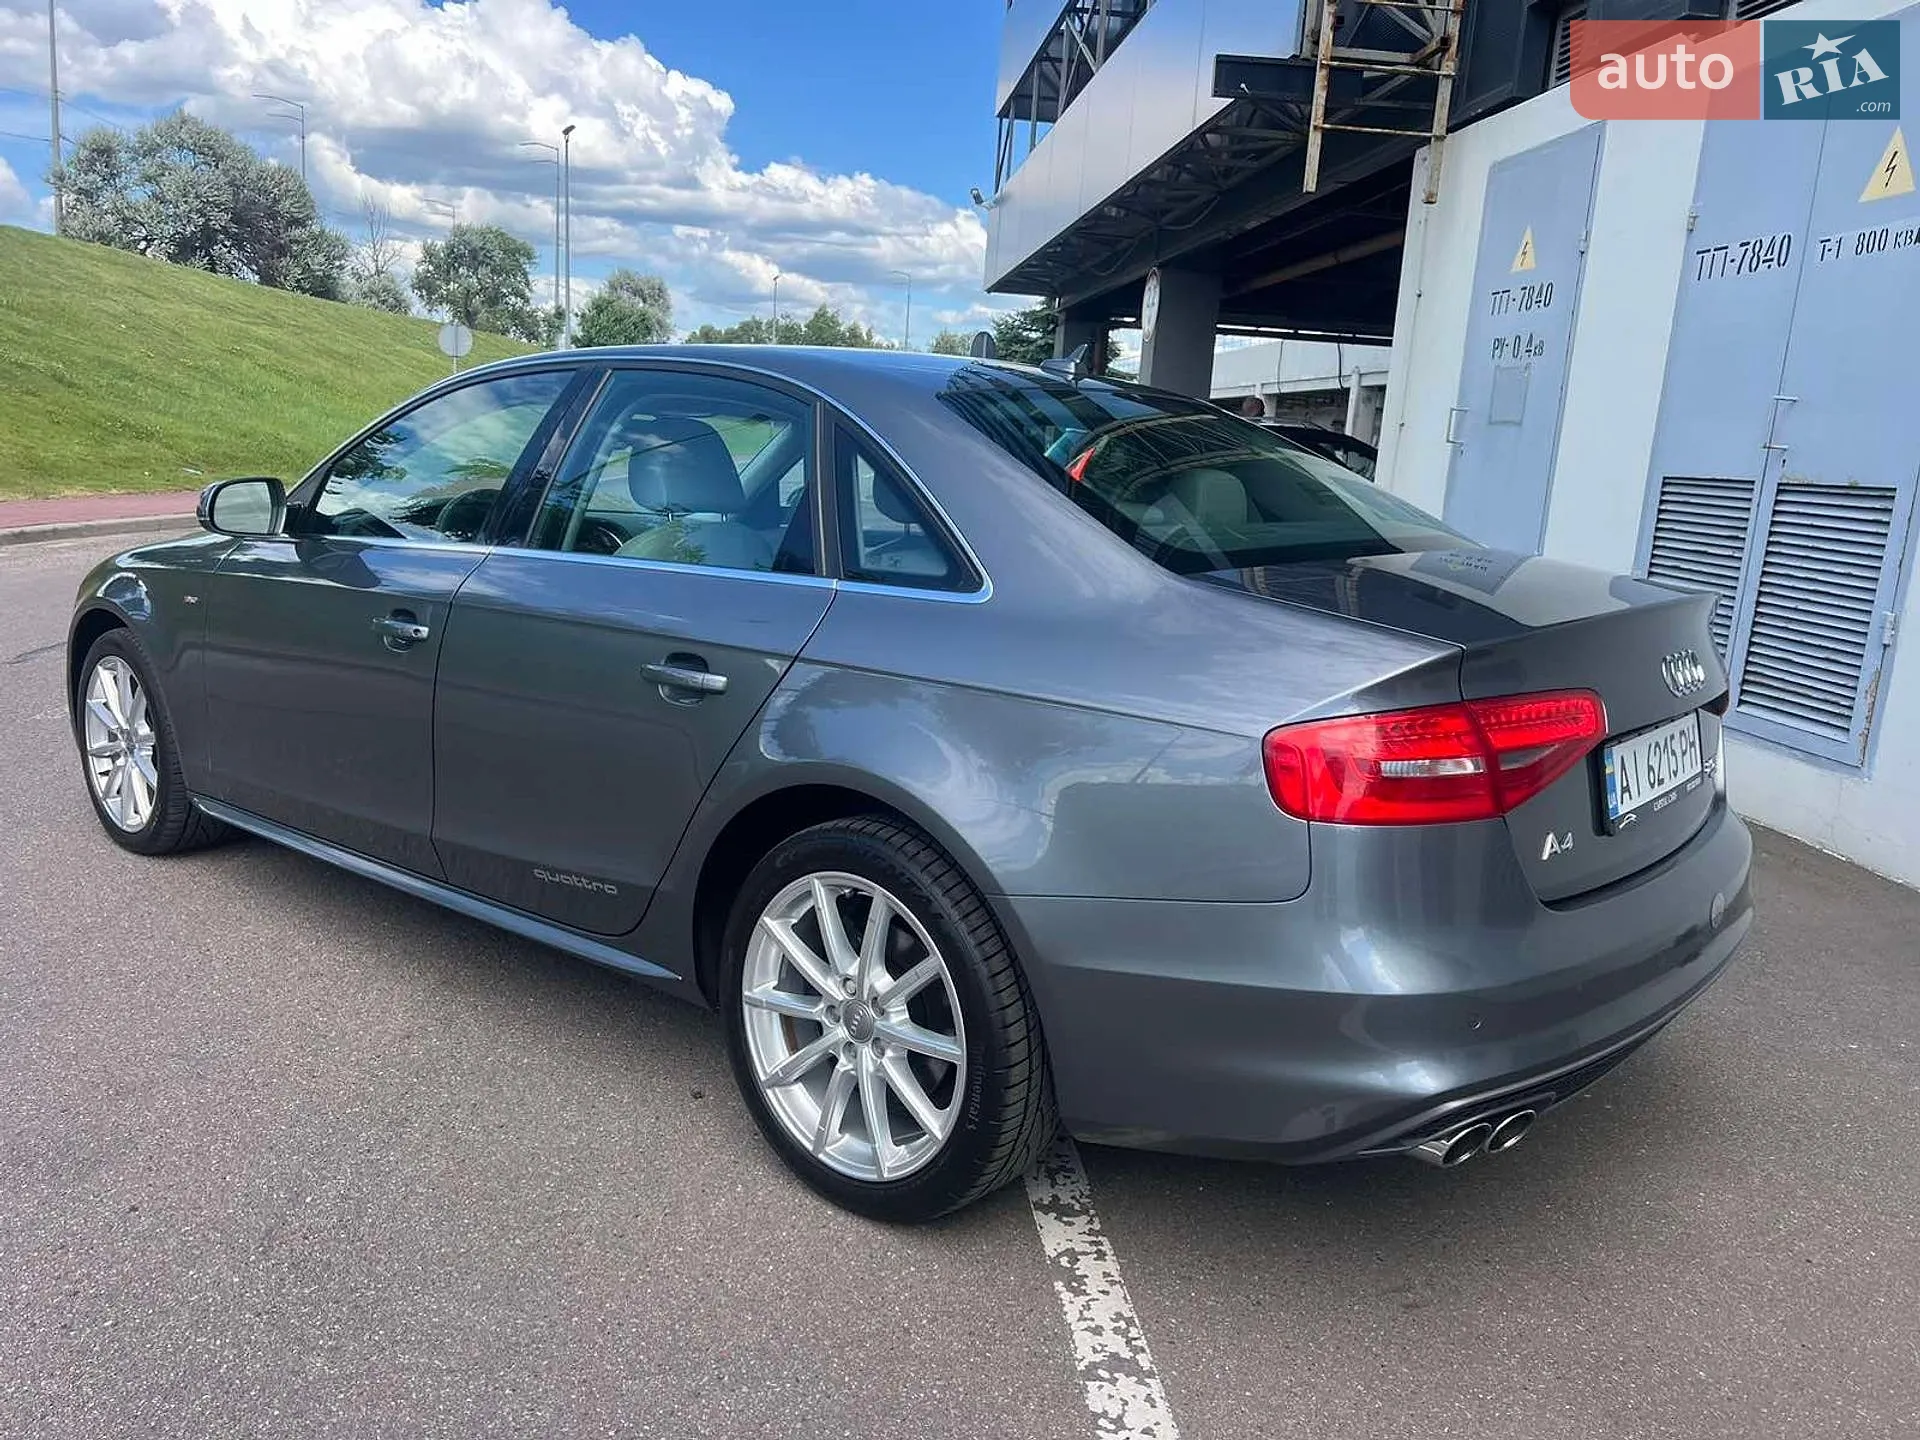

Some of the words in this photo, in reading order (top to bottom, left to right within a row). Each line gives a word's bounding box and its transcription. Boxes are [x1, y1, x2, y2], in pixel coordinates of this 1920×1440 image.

[1855, 228, 1888, 256] 800
[1620, 750, 1640, 805] AI
[1647, 734, 1678, 790] 6215
[1680, 723, 1698, 774] PH
[1541, 832, 1573, 861] A4
[533, 868, 617, 895] quattro
